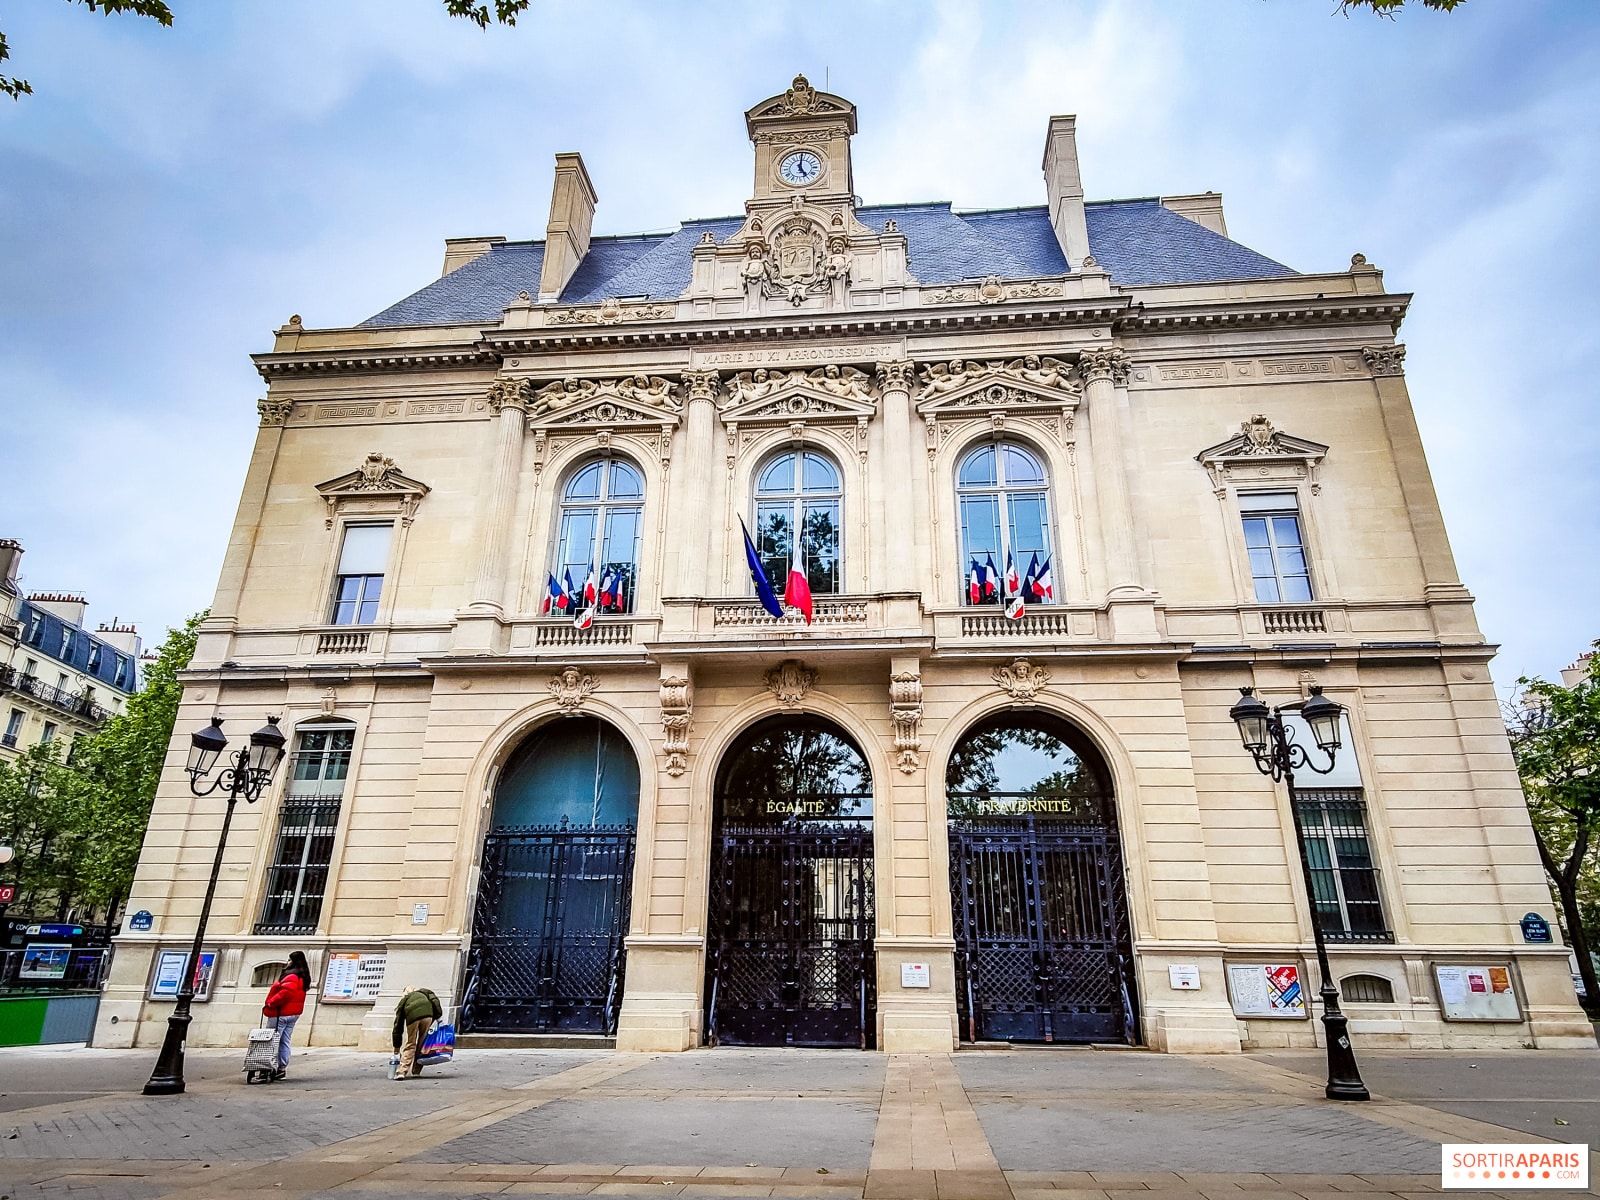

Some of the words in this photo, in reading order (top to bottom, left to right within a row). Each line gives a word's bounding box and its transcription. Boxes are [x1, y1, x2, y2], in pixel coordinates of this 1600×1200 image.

[702, 353, 743, 364] MAIRIE
[747, 352, 763, 362] DU
[767, 351, 781, 361] XI
[785, 346, 892, 360] ARRONDISSEMENT
[766, 799, 825, 813] ÉGALITÉ
[980, 798, 1071, 812] FRATERNITÉ
